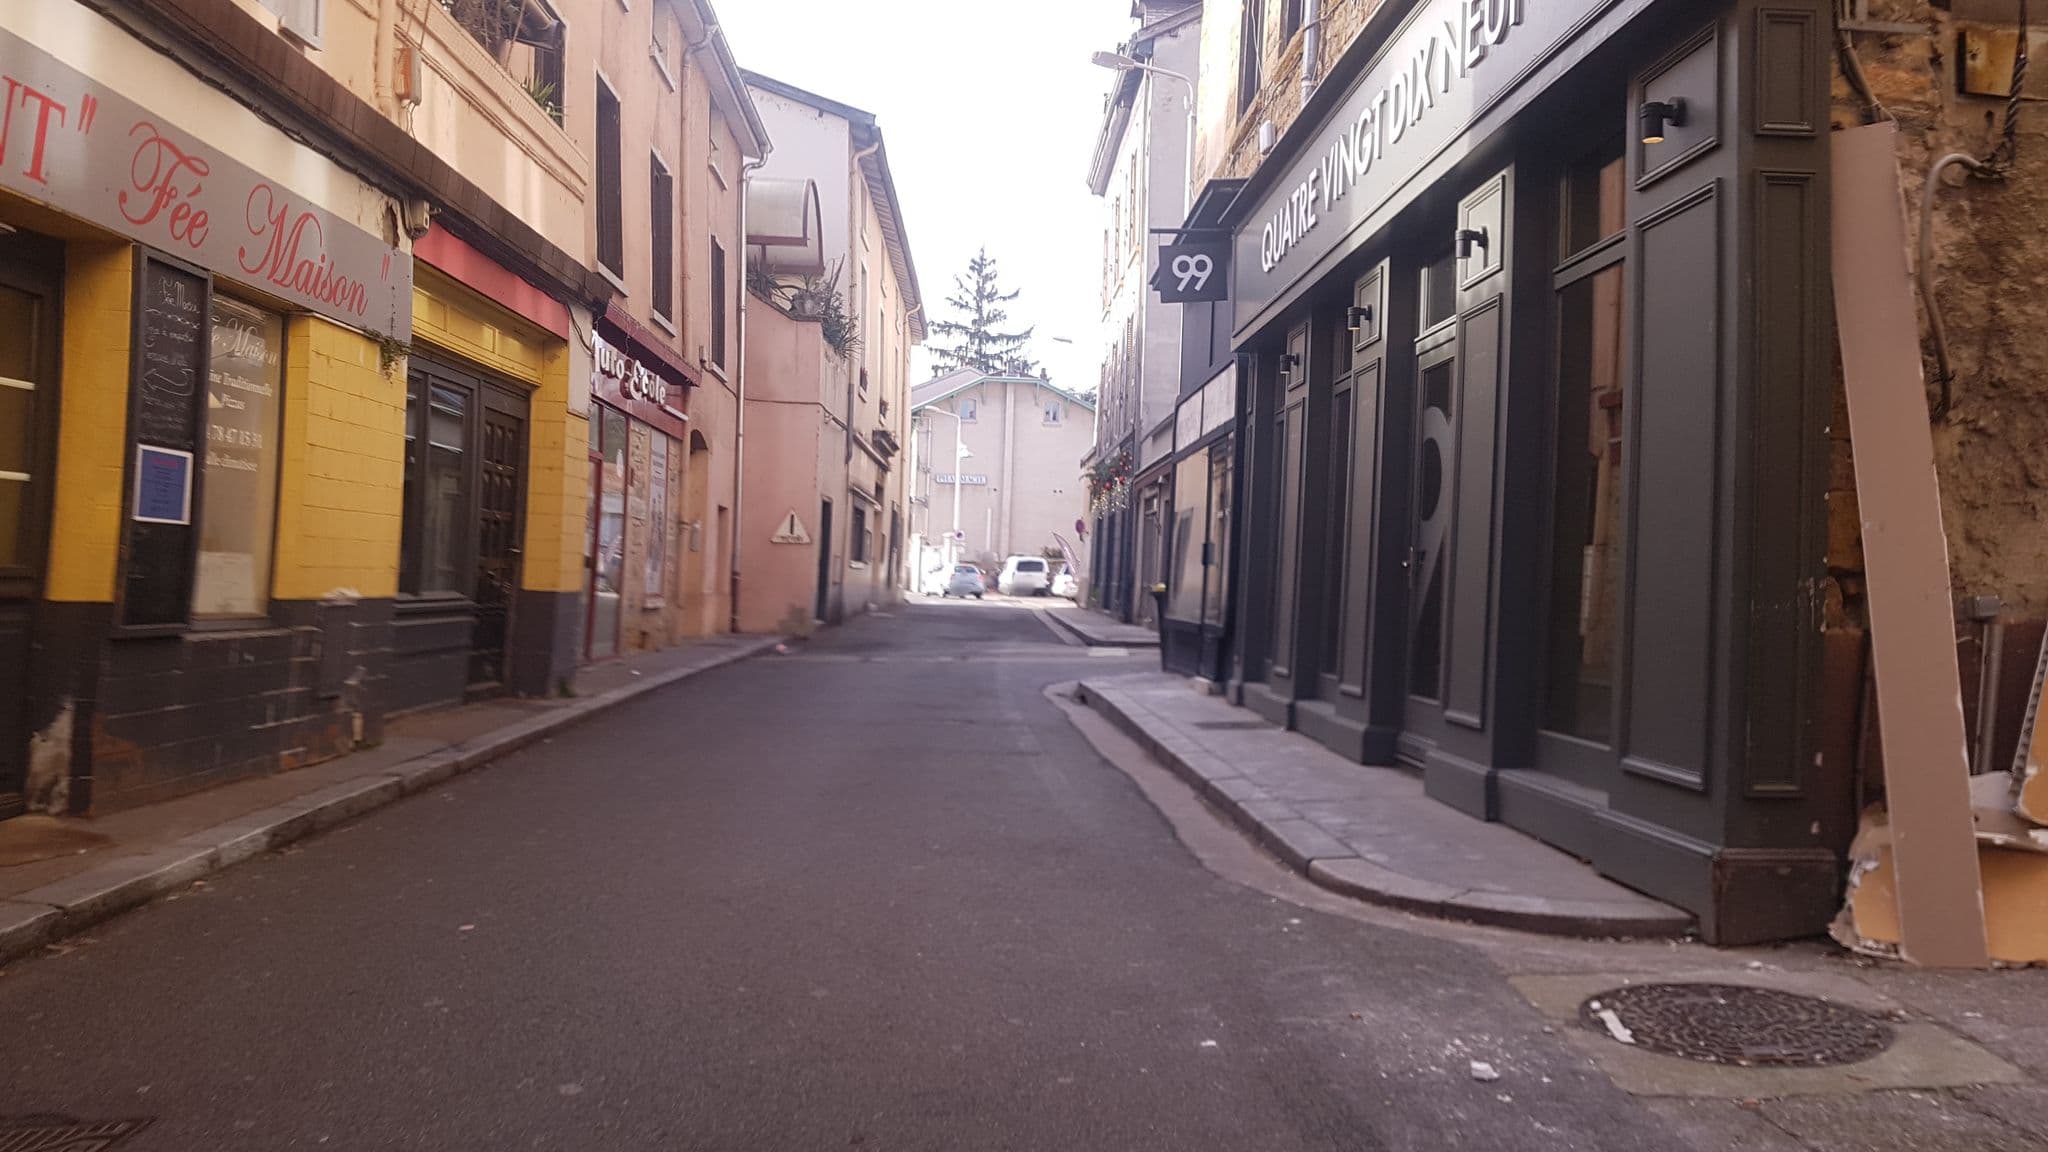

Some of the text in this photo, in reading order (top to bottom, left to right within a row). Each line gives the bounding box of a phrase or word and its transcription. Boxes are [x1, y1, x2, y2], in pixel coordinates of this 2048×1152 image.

[1262, 168, 1319, 273] QUATRE
[1322, 89, 1387, 212] VINGT
[1389, 36, 1436, 144] DIX
[119, 121, 210, 248] Fée
[238, 184, 368, 316] Maison
[1172, 254, 1213, 292] 99
[936, 473, 986, 485] PHAMACIE
